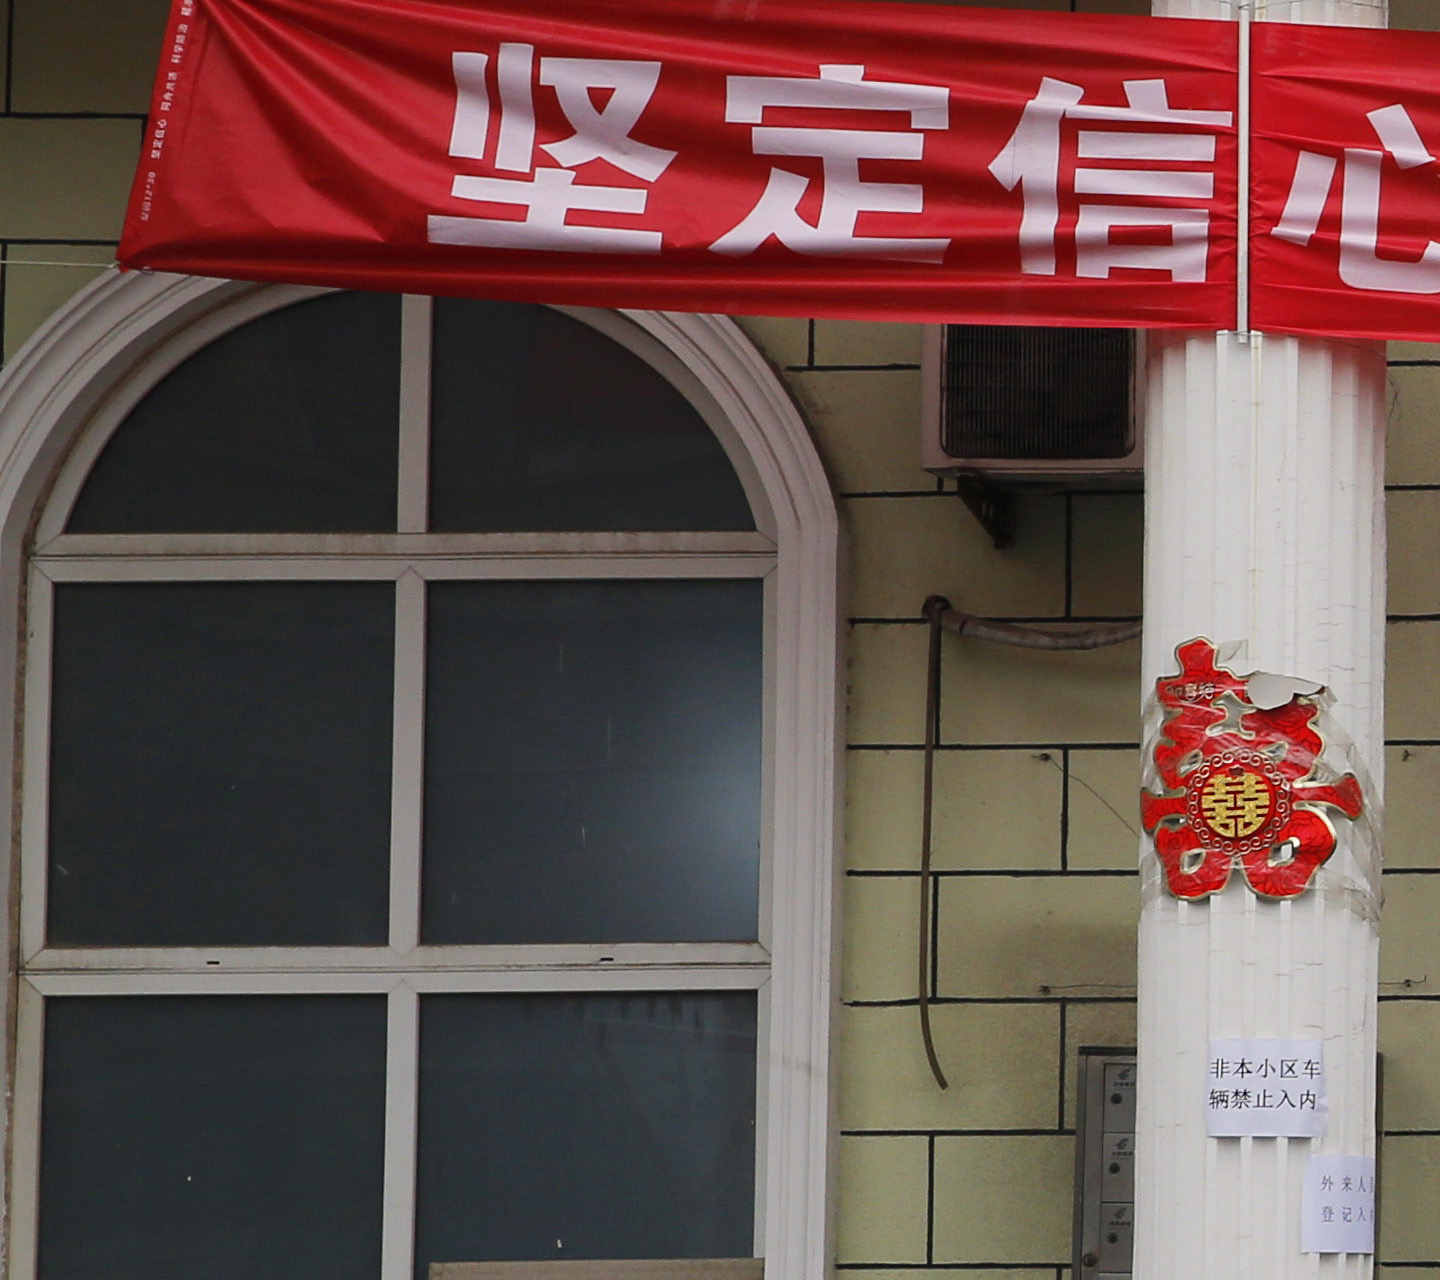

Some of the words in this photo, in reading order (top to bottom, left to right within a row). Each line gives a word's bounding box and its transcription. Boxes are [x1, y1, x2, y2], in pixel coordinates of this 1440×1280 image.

[1210, 1058, 1321, 1080] 非本小区车
[1208, 1089, 1317, 1110] 辆禁止入内
